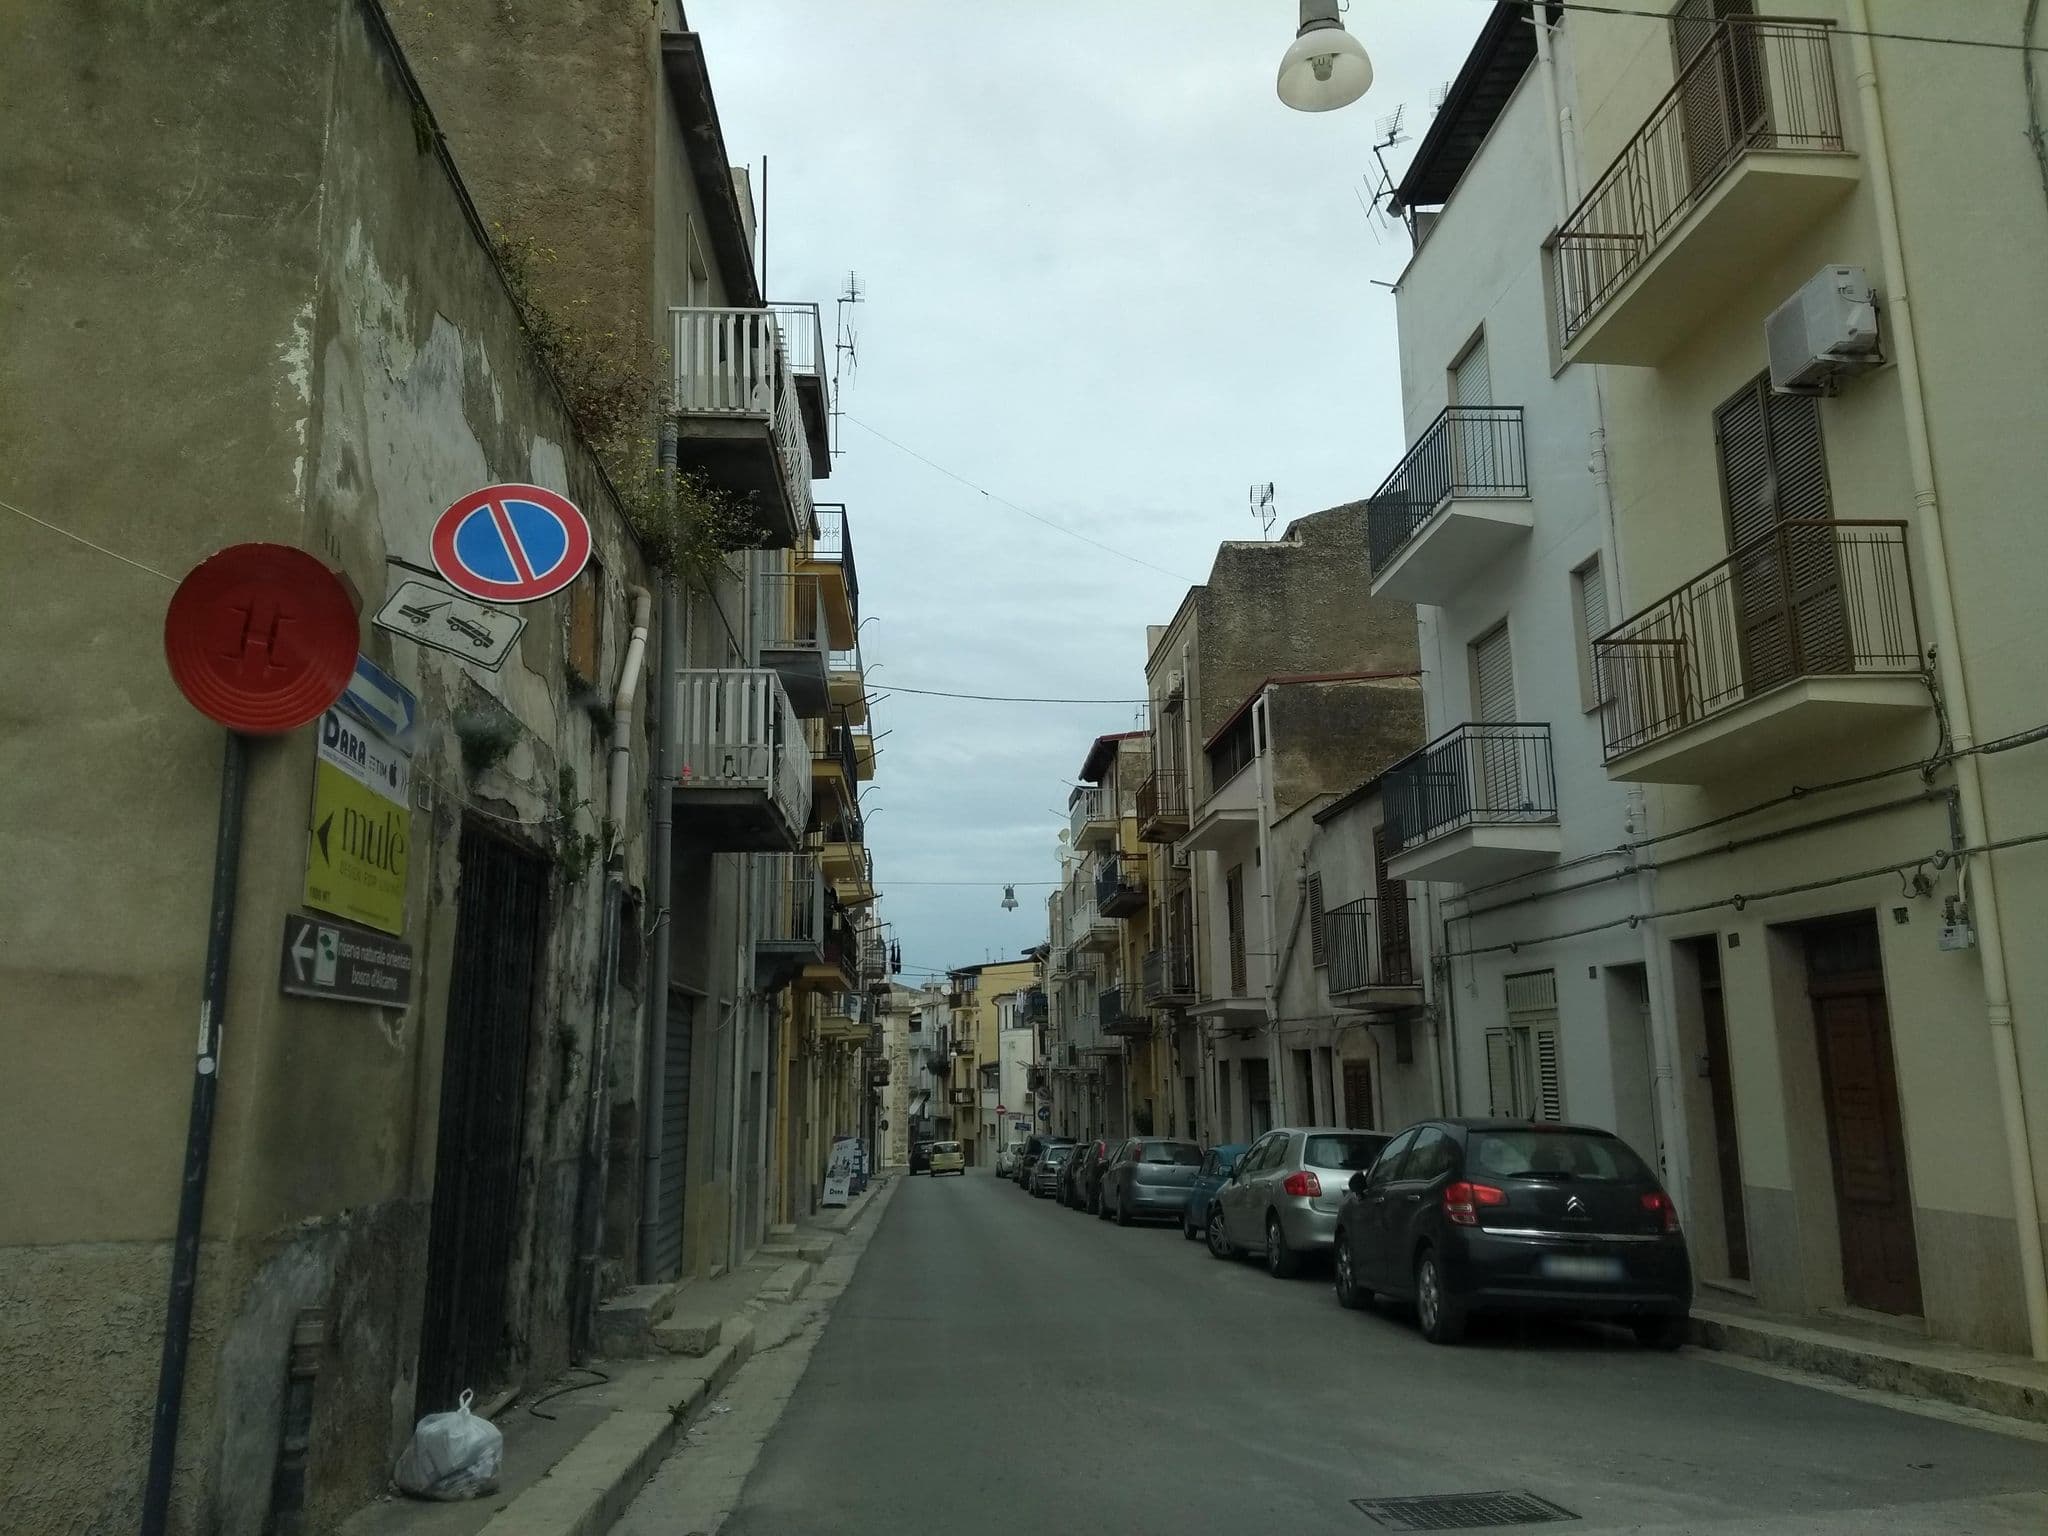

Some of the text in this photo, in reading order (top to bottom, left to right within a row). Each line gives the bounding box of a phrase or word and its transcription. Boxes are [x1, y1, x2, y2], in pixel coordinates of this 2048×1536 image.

[324, 709, 366, 765] DARA
[342, 808, 404, 875] mulè
[339, 939, 411, 970] riserva naturale orientata
[352, 964, 370, 986] bosco
